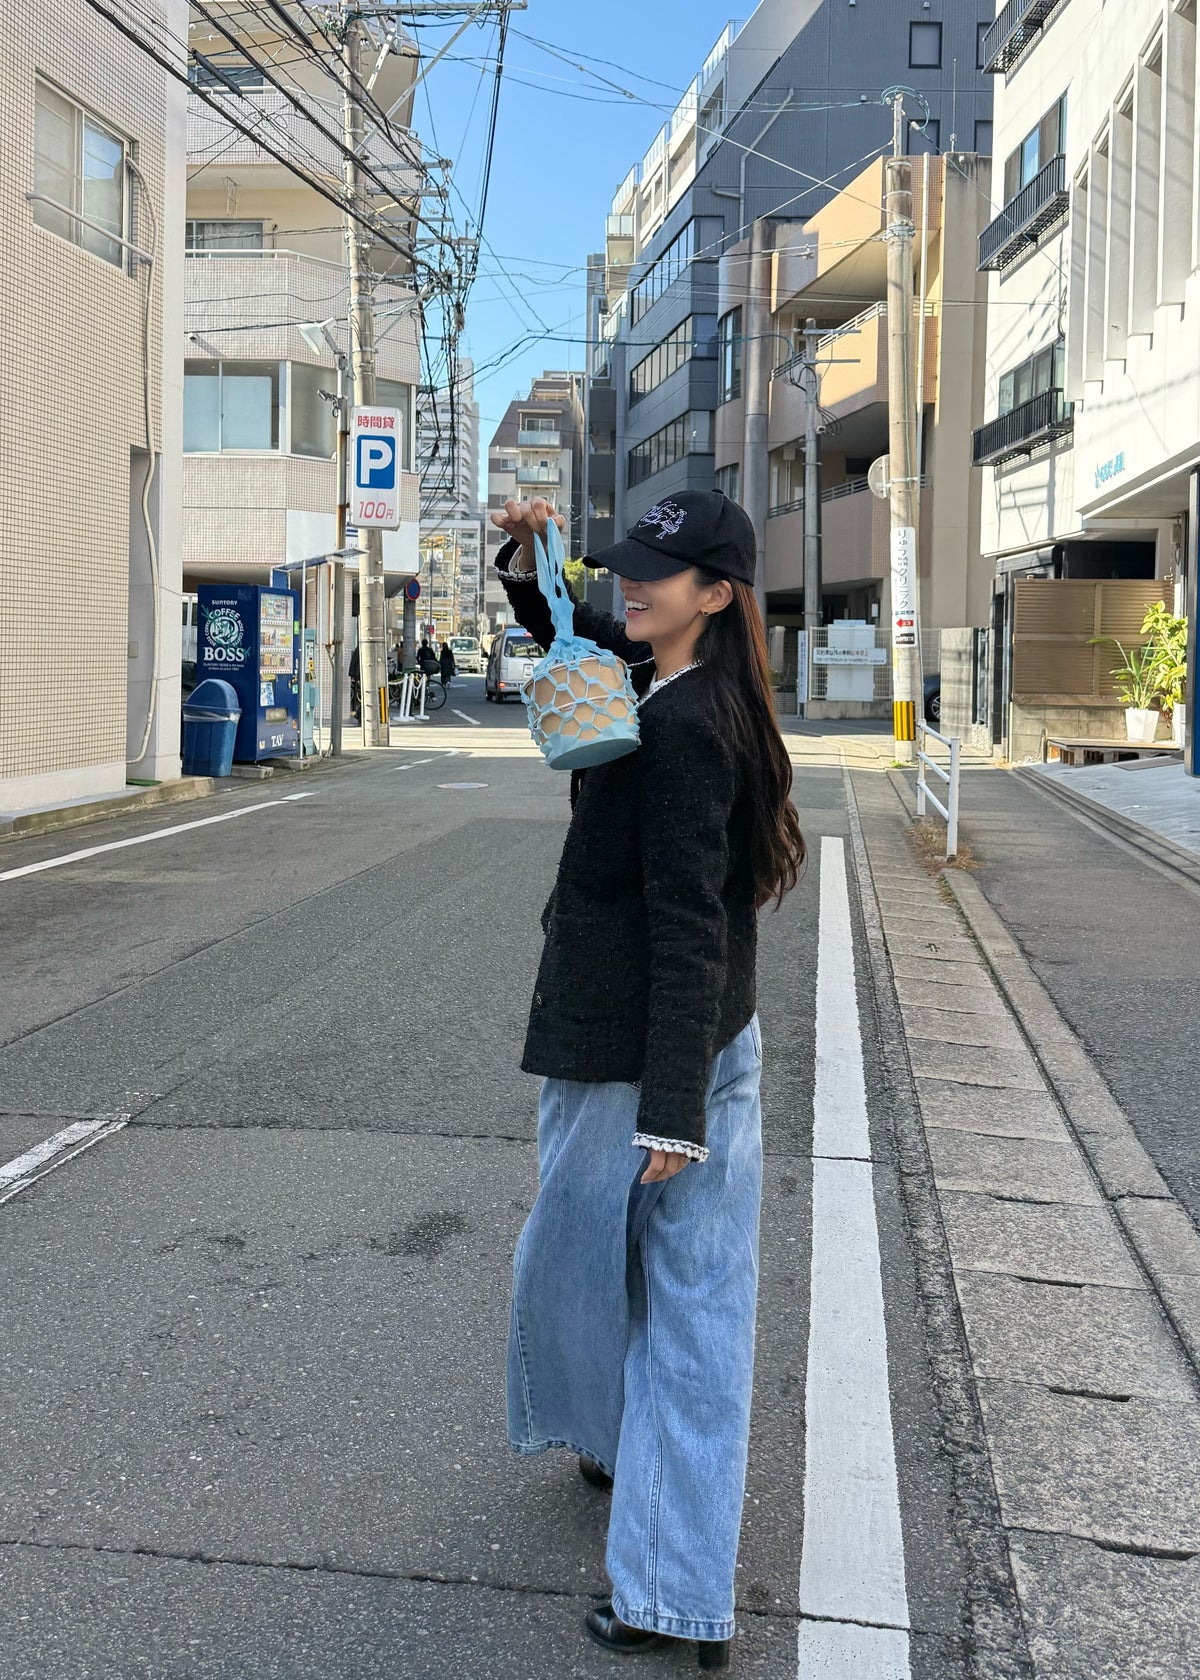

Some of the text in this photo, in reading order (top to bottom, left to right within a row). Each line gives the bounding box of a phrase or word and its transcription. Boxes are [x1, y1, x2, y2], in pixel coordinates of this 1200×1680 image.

[357, 415, 395, 429] 時間貸
[360, 439, 393, 485] P
[359, 501, 394, 520] 100円
[208, 607, 241, 620] COFFEE
[203, 646, 245, 662] BOSS
